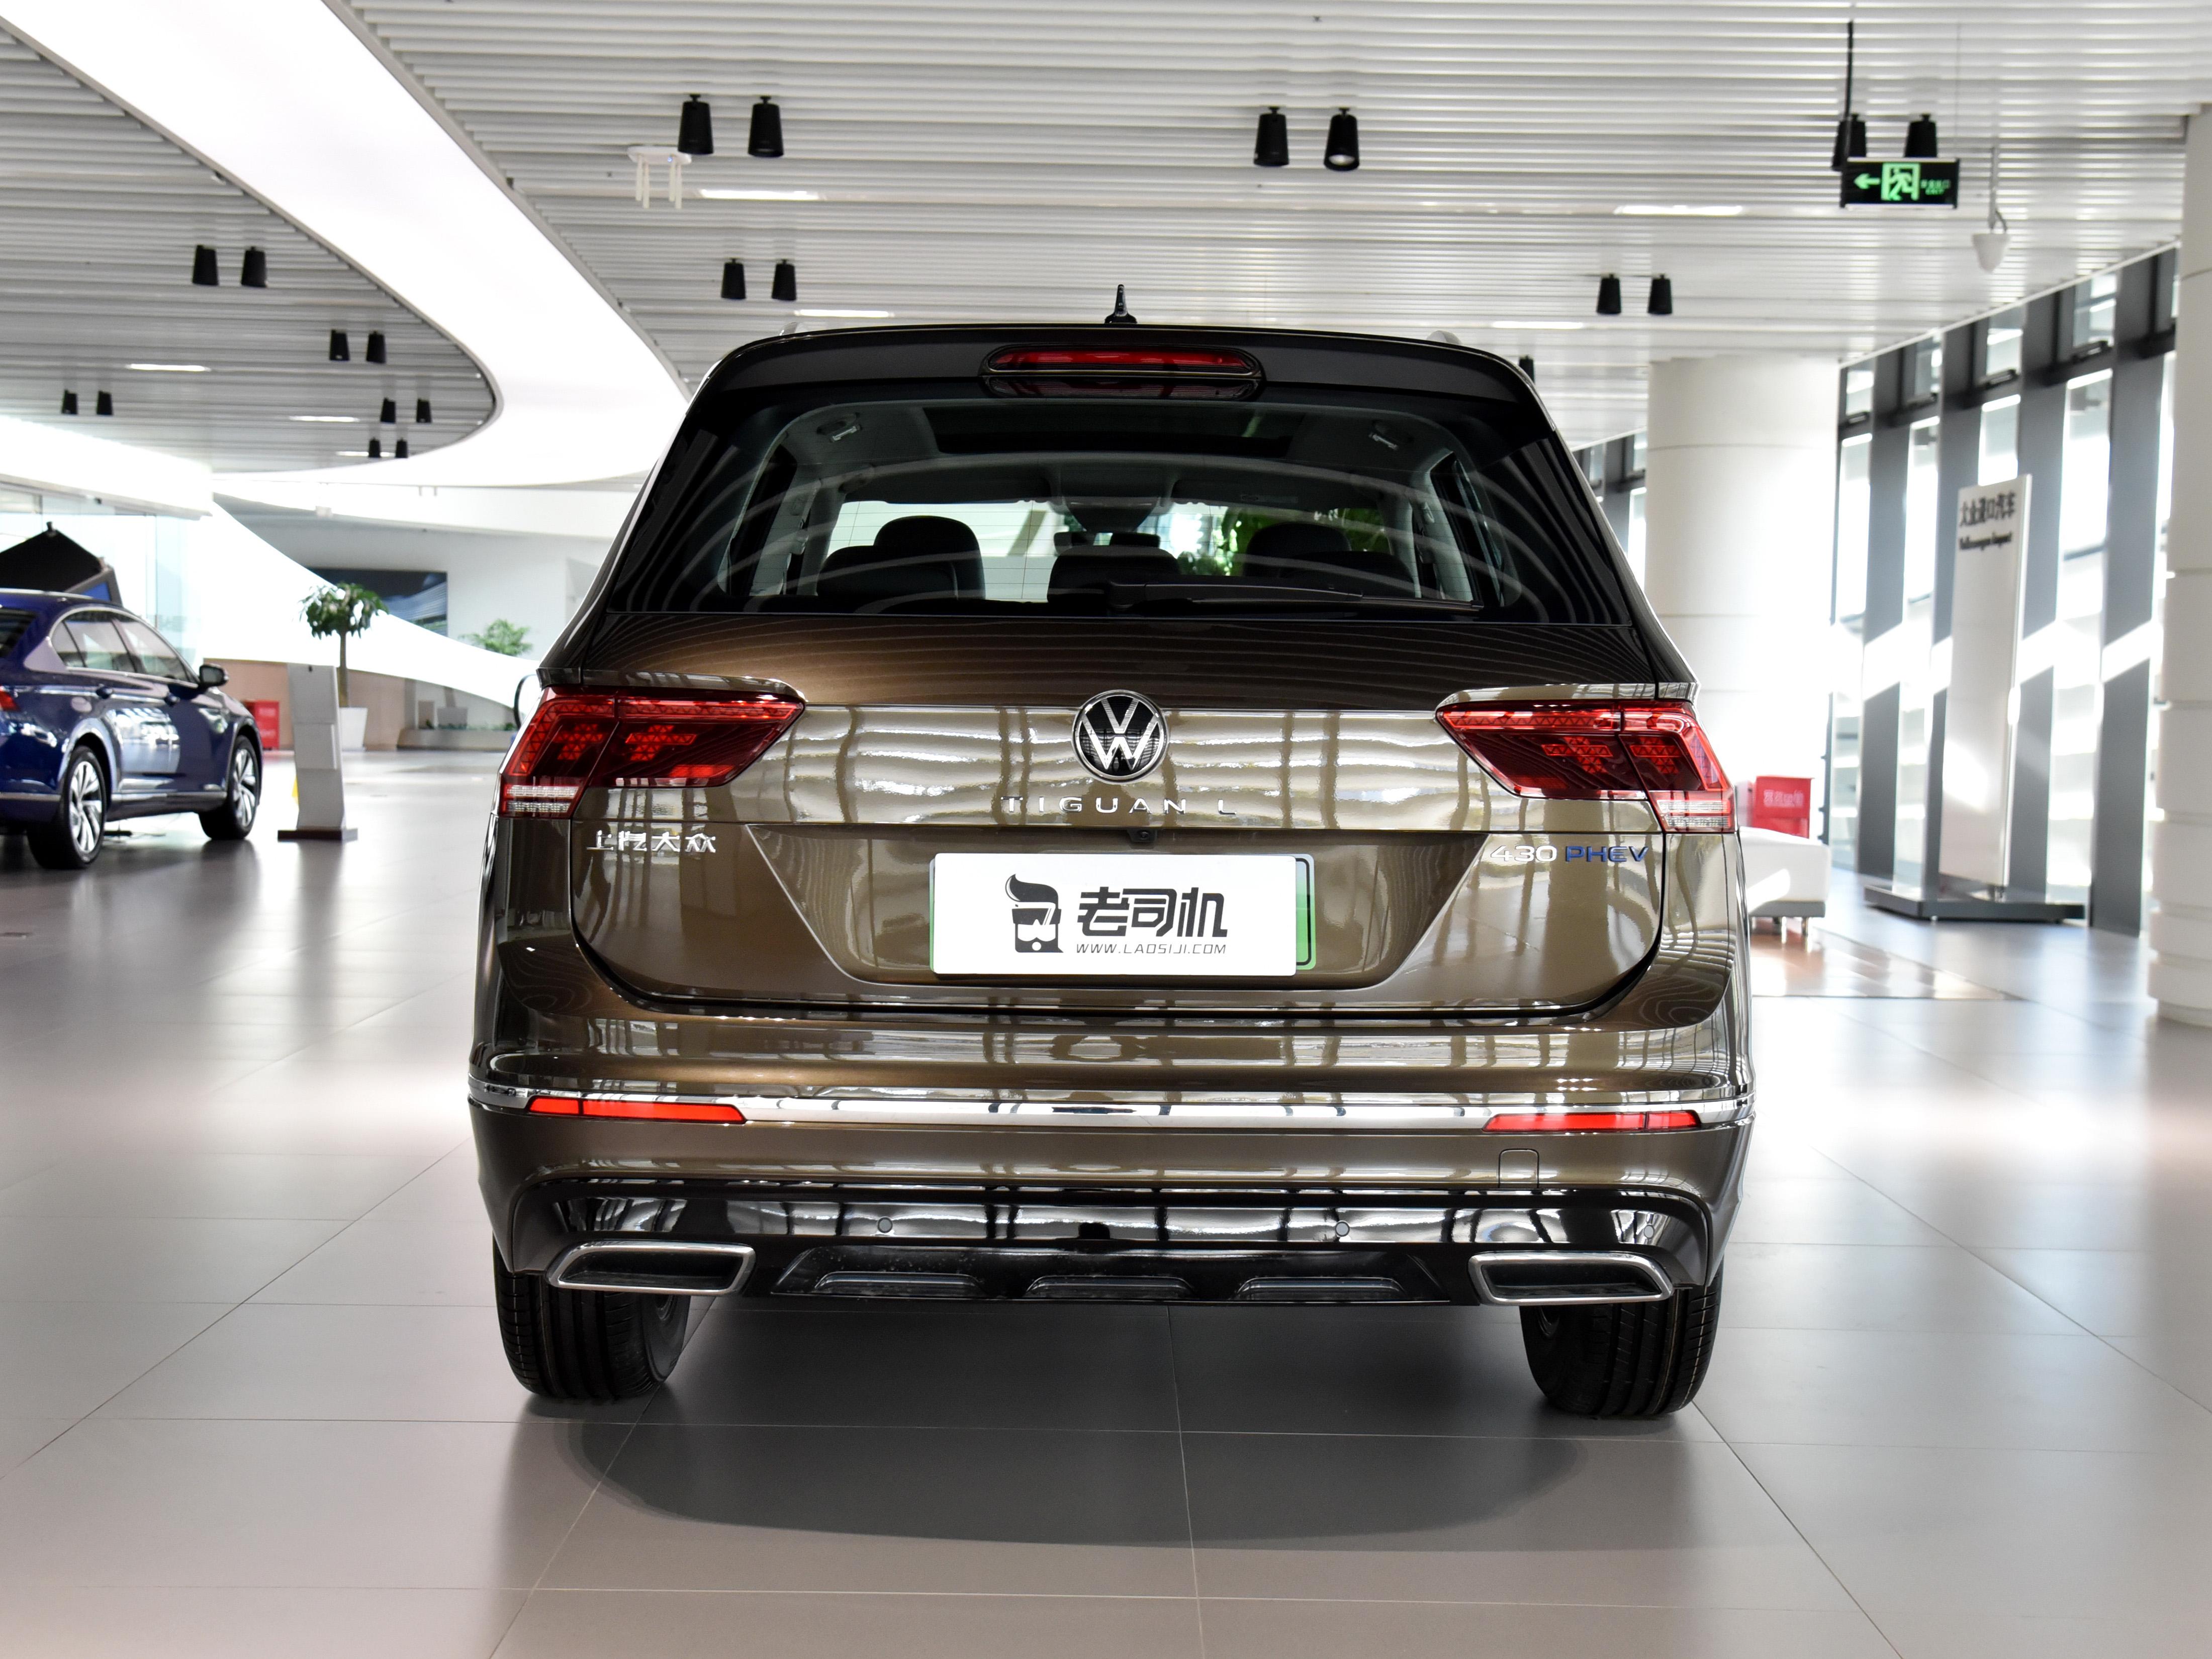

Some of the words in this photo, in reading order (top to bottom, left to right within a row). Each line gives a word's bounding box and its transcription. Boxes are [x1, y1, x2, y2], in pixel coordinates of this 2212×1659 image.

[1000, 796, 1186, 815] TIGUAN
[1218, 799, 1237, 815] L
[1490, 845, 1557, 862] 430
[1565, 846, 1649, 862] PHEV
[1076, 886, 1228, 938] 老司机
[1076, 943, 1227, 954] WWW.LAOSIJI.COM
